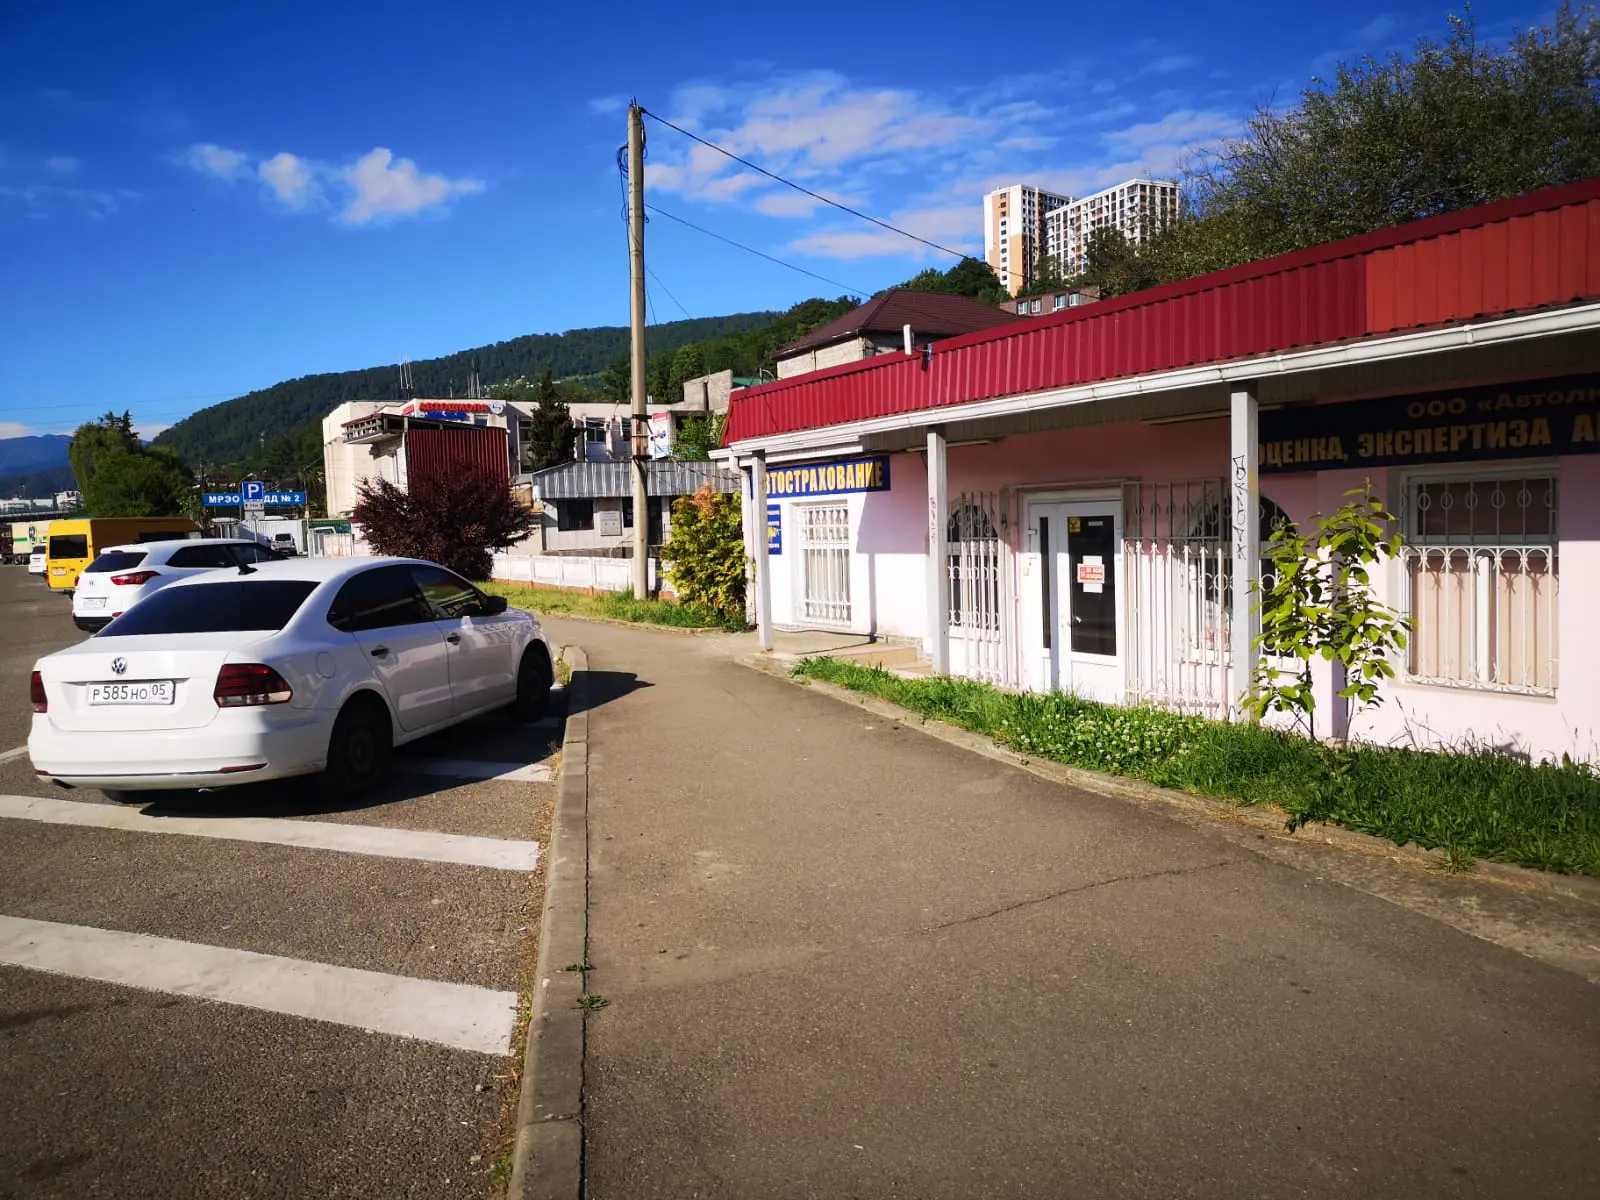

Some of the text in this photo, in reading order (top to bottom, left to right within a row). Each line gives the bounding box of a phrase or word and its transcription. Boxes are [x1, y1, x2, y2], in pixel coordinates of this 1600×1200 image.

[1407, 397, 1467, 418] ООО
[1357, 417, 1552, 458] ЭКСПЕРТИЗА
[208, 494, 240, 504] МРЭО
[294, 494, 300, 502] 2
[151, 684, 167, 696] 05
